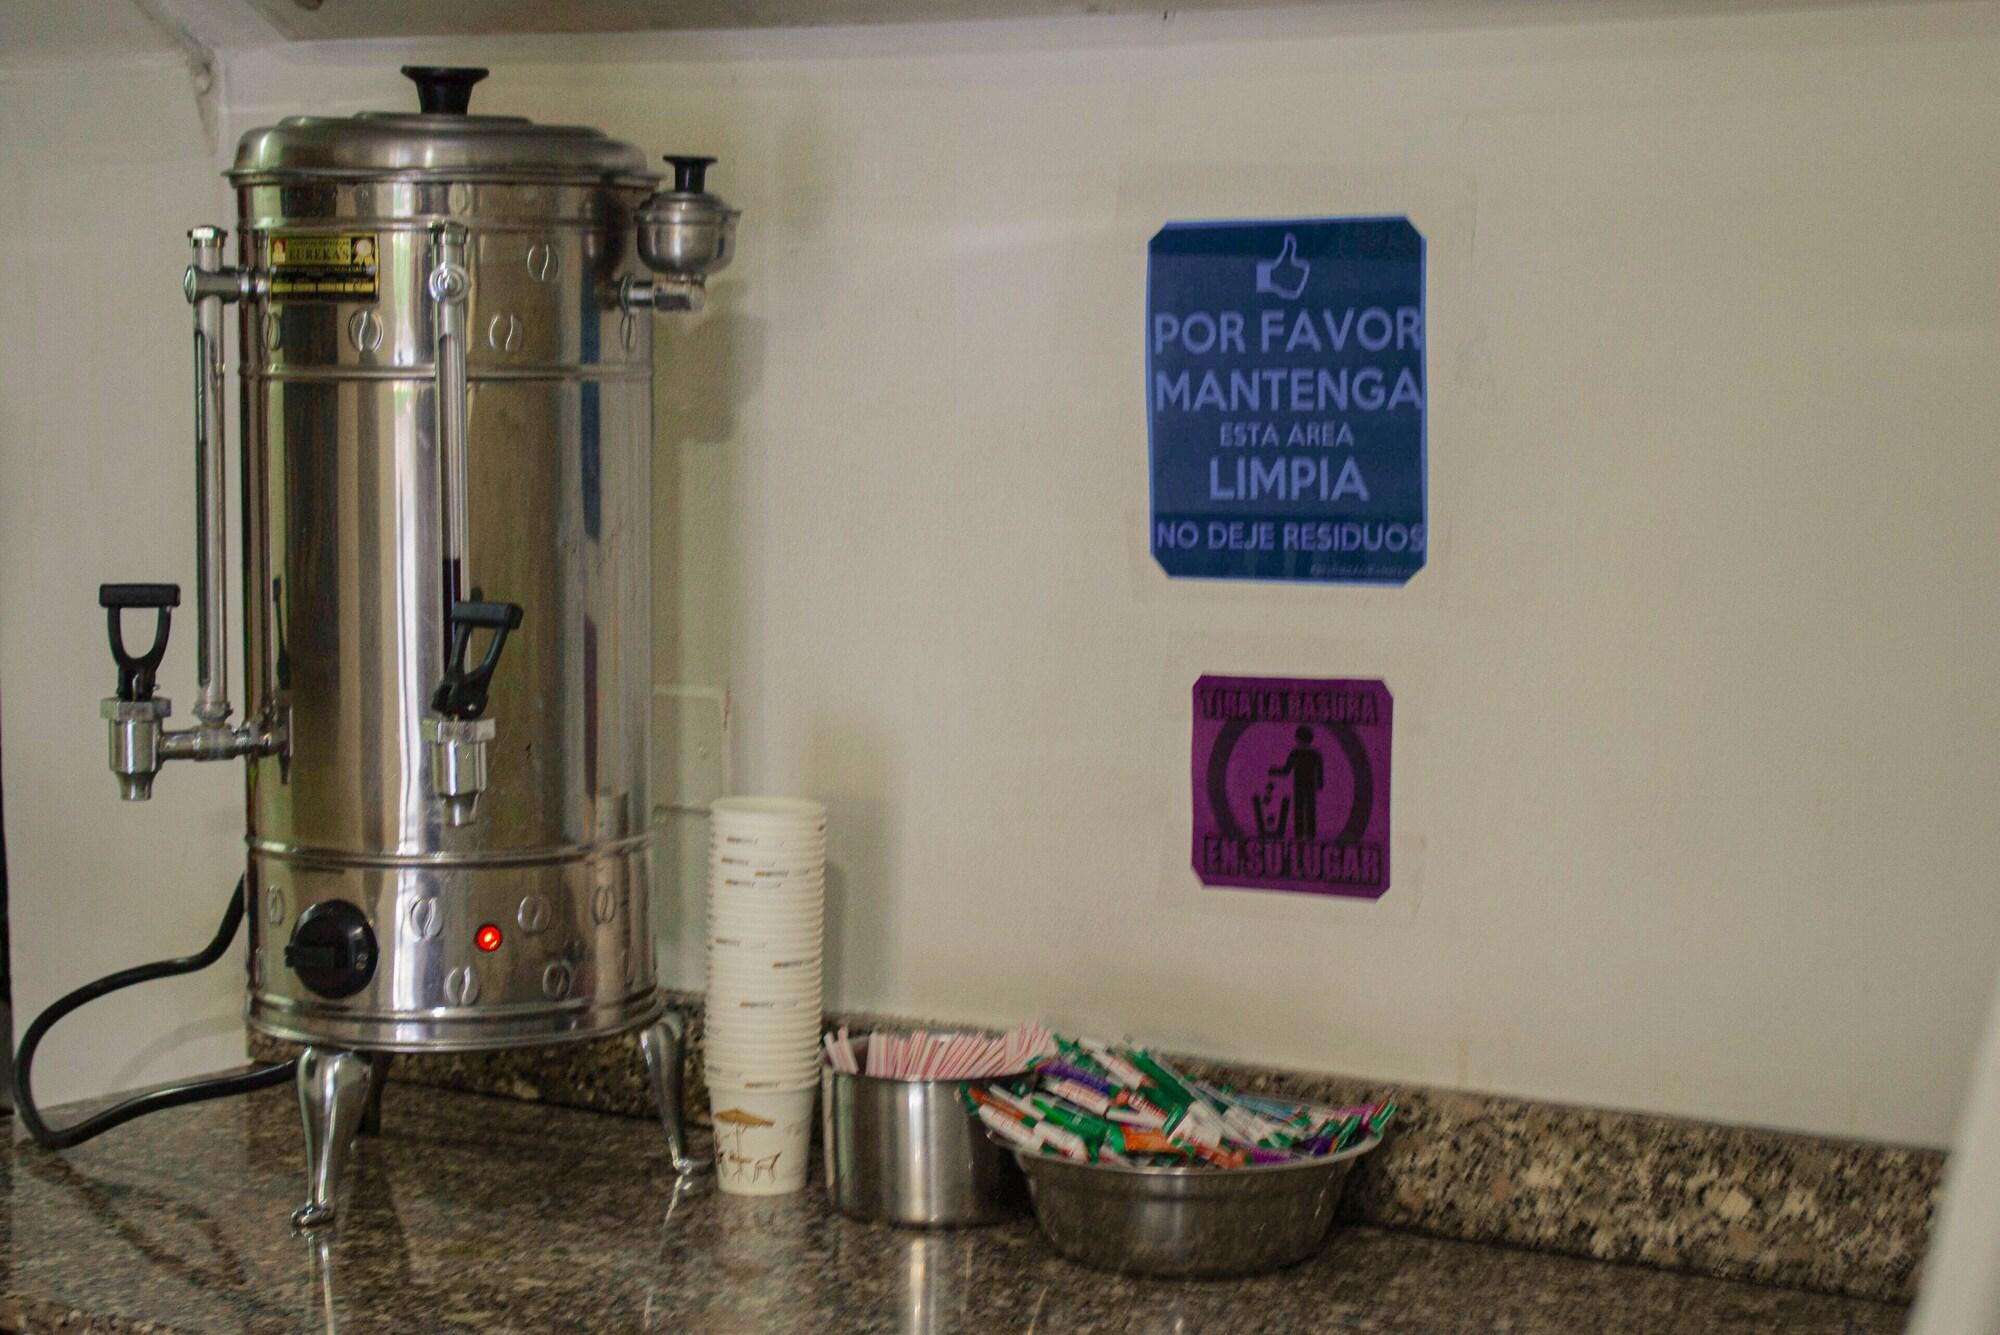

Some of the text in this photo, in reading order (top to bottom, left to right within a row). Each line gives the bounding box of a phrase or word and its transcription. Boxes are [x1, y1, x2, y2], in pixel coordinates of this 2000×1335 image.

[1154, 306, 1424, 354] POR FAVOR
[1156, 367, 1423, 412] MANTENGA
[1220, 421, 1354, 447] ESTA AREA
[1209, 455, 1370, 503] LIMPIA
[1157, 521, 1424, 552] NO DEJE RESIDUOS
[1256, 689, 1281, 722] LA
[1287, 690, 1378, 725] BASURA
[1245, 840, 1283, 879] SU
[1287, 843, 1382, 885] LUGAR
